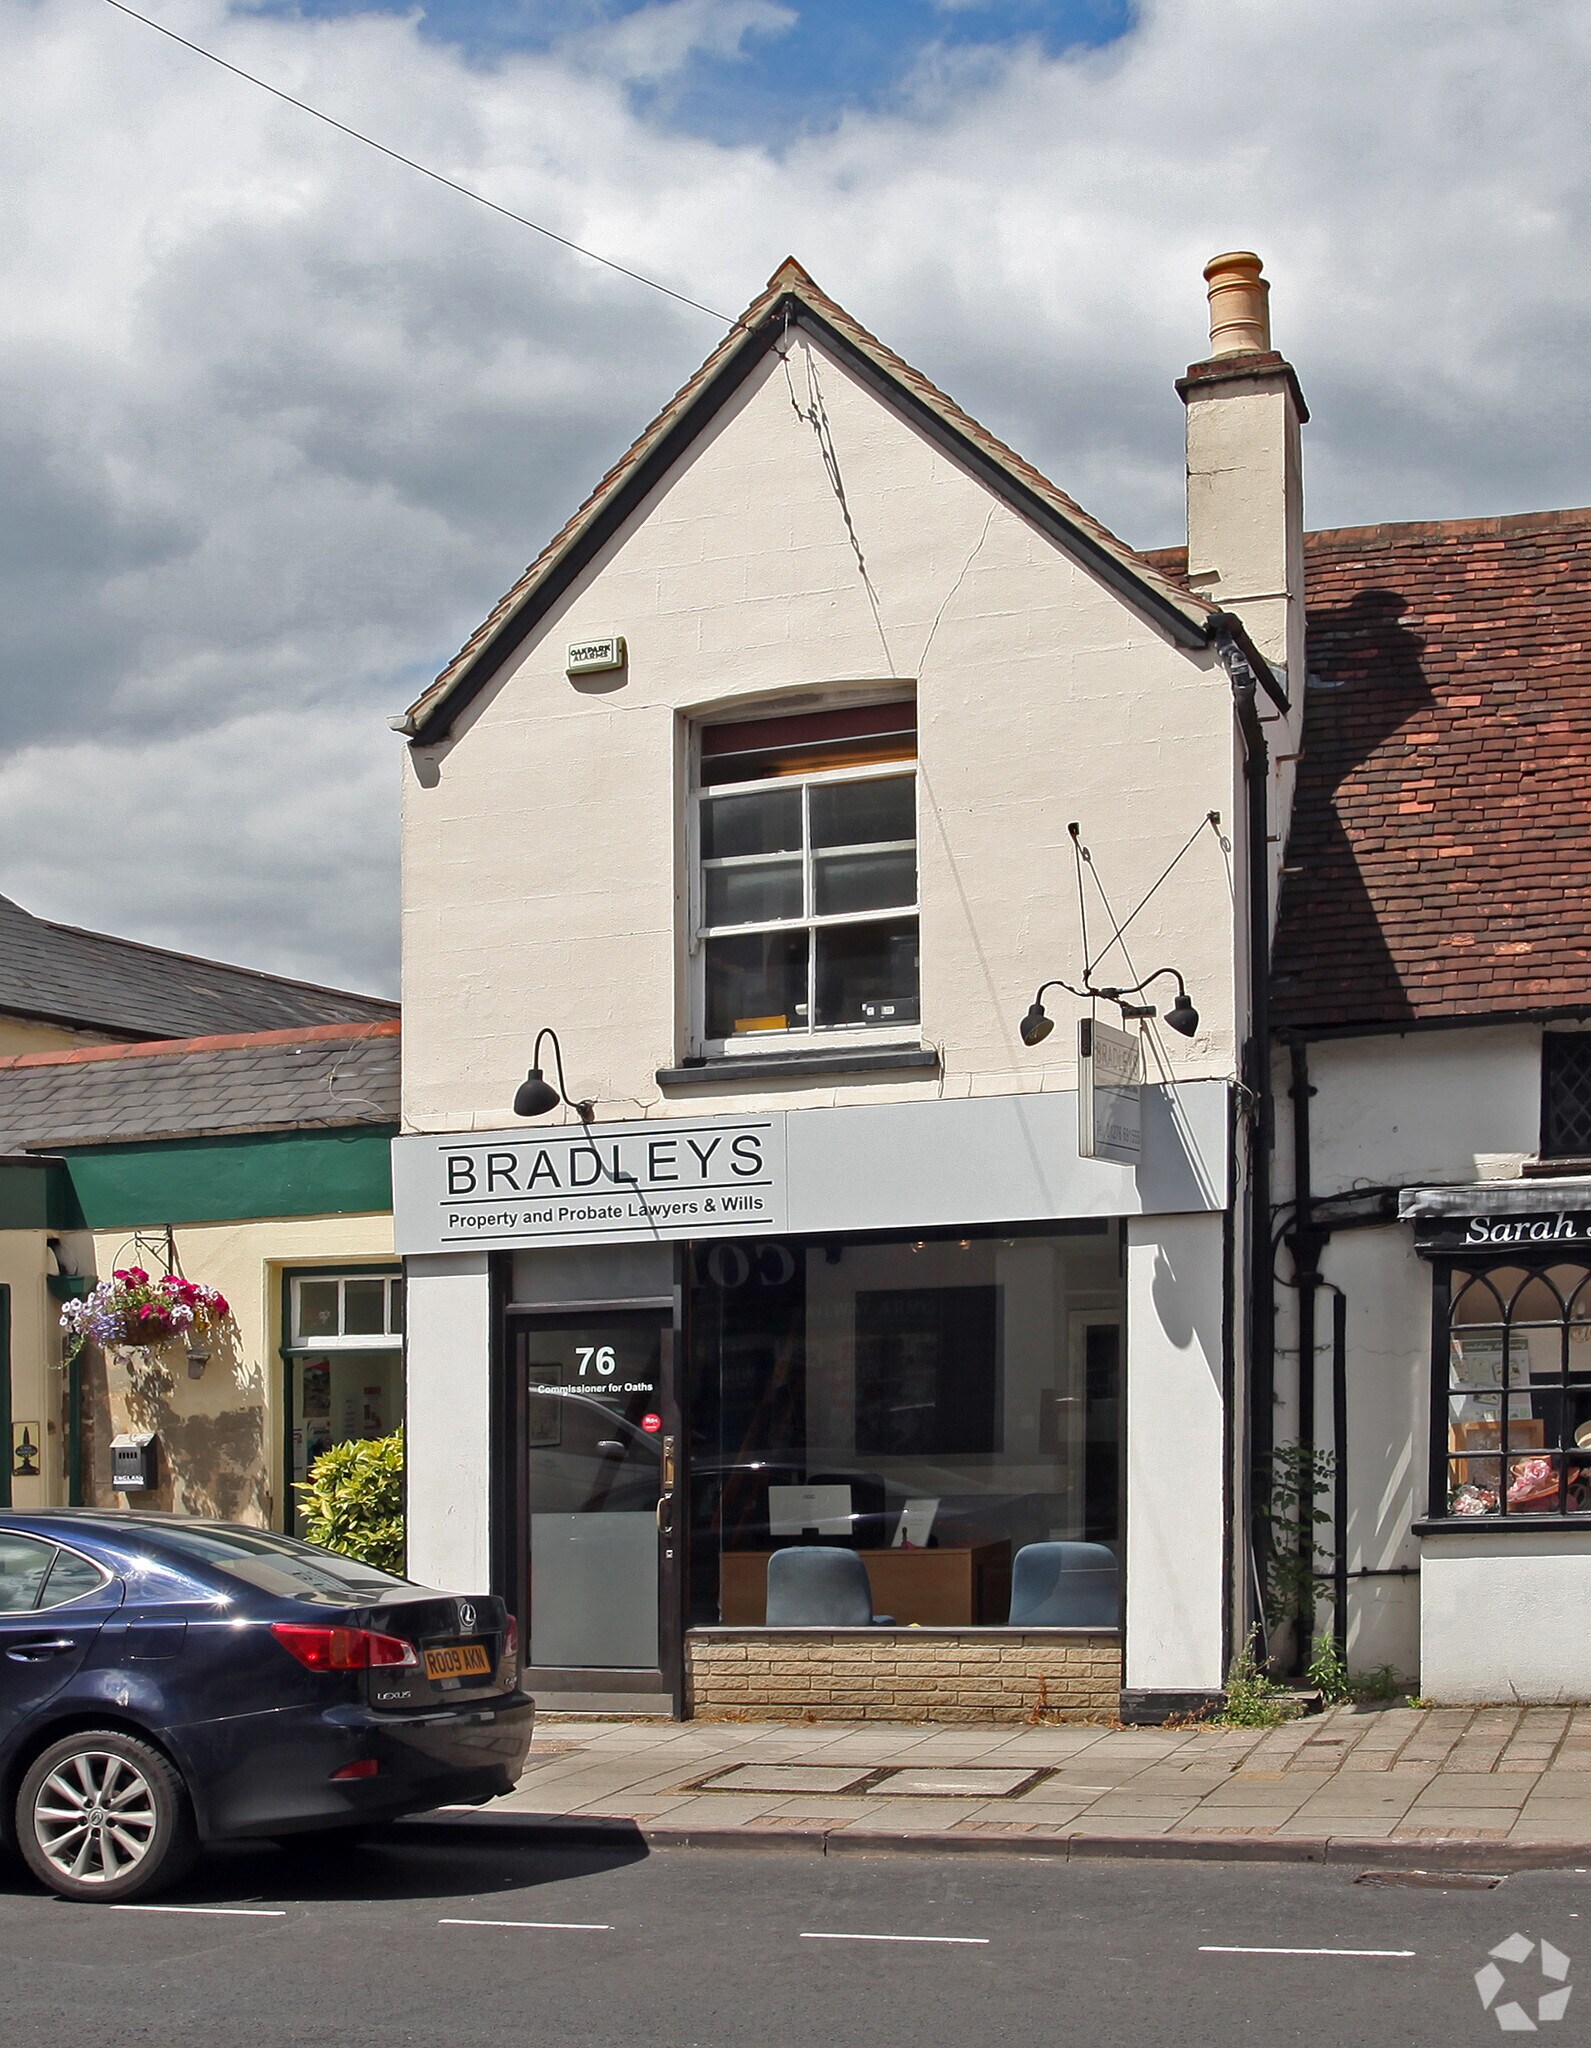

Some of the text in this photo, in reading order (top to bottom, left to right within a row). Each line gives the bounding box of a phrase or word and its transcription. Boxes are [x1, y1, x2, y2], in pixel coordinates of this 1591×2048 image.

[570, 645, 610, 656] OAKPARK
[447, 1134, 764, 1195] BRADLEYS
[448, 1195, 764, 1230] Property and Probate Lawyers & Wills
[1465, 1211, 1577, 1244] Sarah
[575, 1346, 616, 1376] 76
[537, 1382, 653, 1394] Commissioner for Oaths
[465, 1647, 486, 1671] AKN
[377, 1690, 412, 1700] LEXUS
